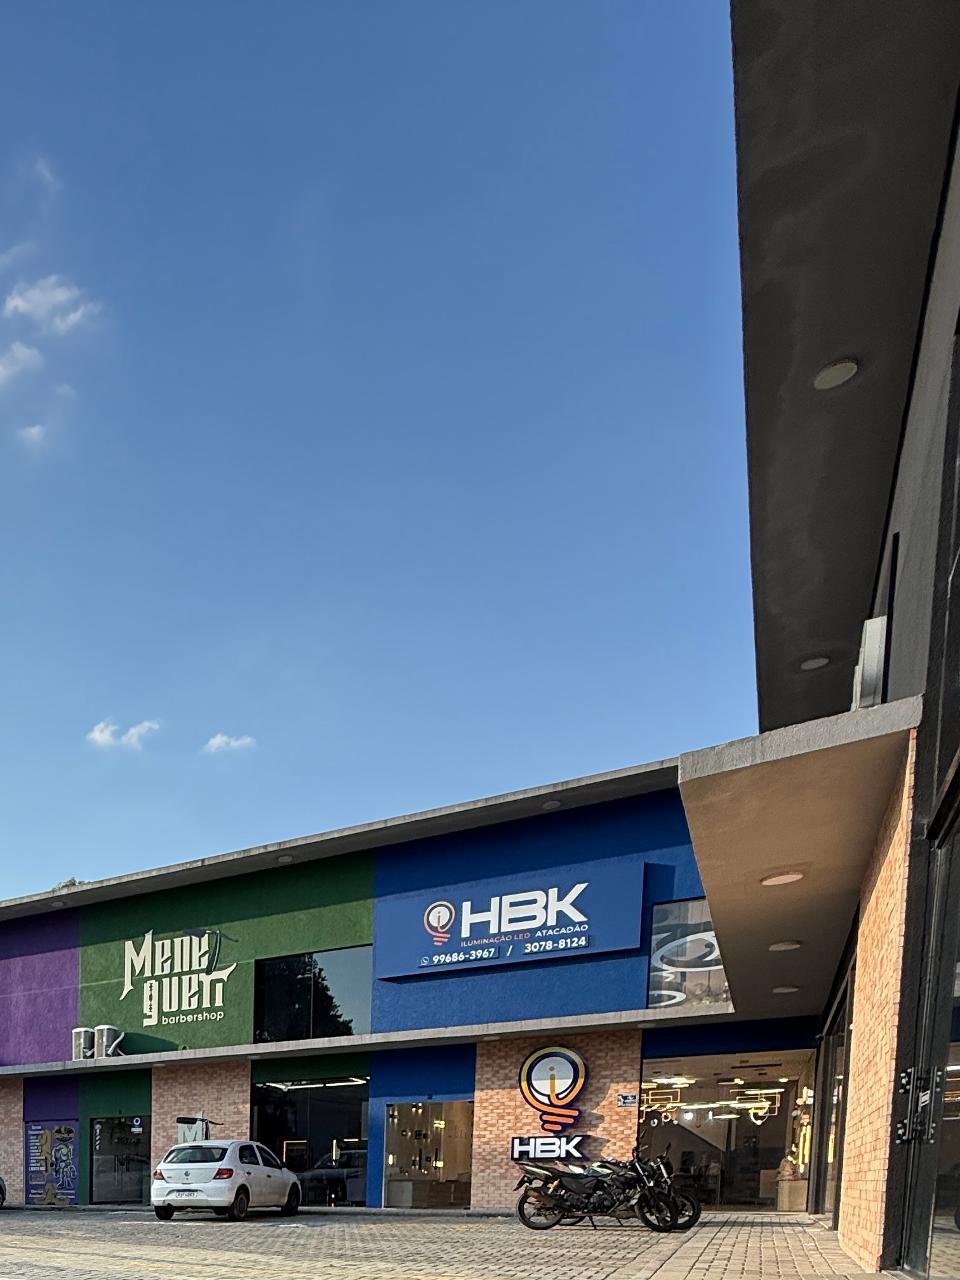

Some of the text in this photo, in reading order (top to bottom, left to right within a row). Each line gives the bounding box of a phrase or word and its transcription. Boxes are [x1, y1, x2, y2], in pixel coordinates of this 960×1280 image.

[460, 882, 590, 939] HBK
[514, 932, 532, 940] LED
[534, 924, 589, 938] ATACADÃO
[432, 947, 496, 964] 99686-3967
[524, 936, 587, 953] 3078-8124
[161, 1011, 225, 1025] barbershop
[513, 1136, 583, 1159] HBK
